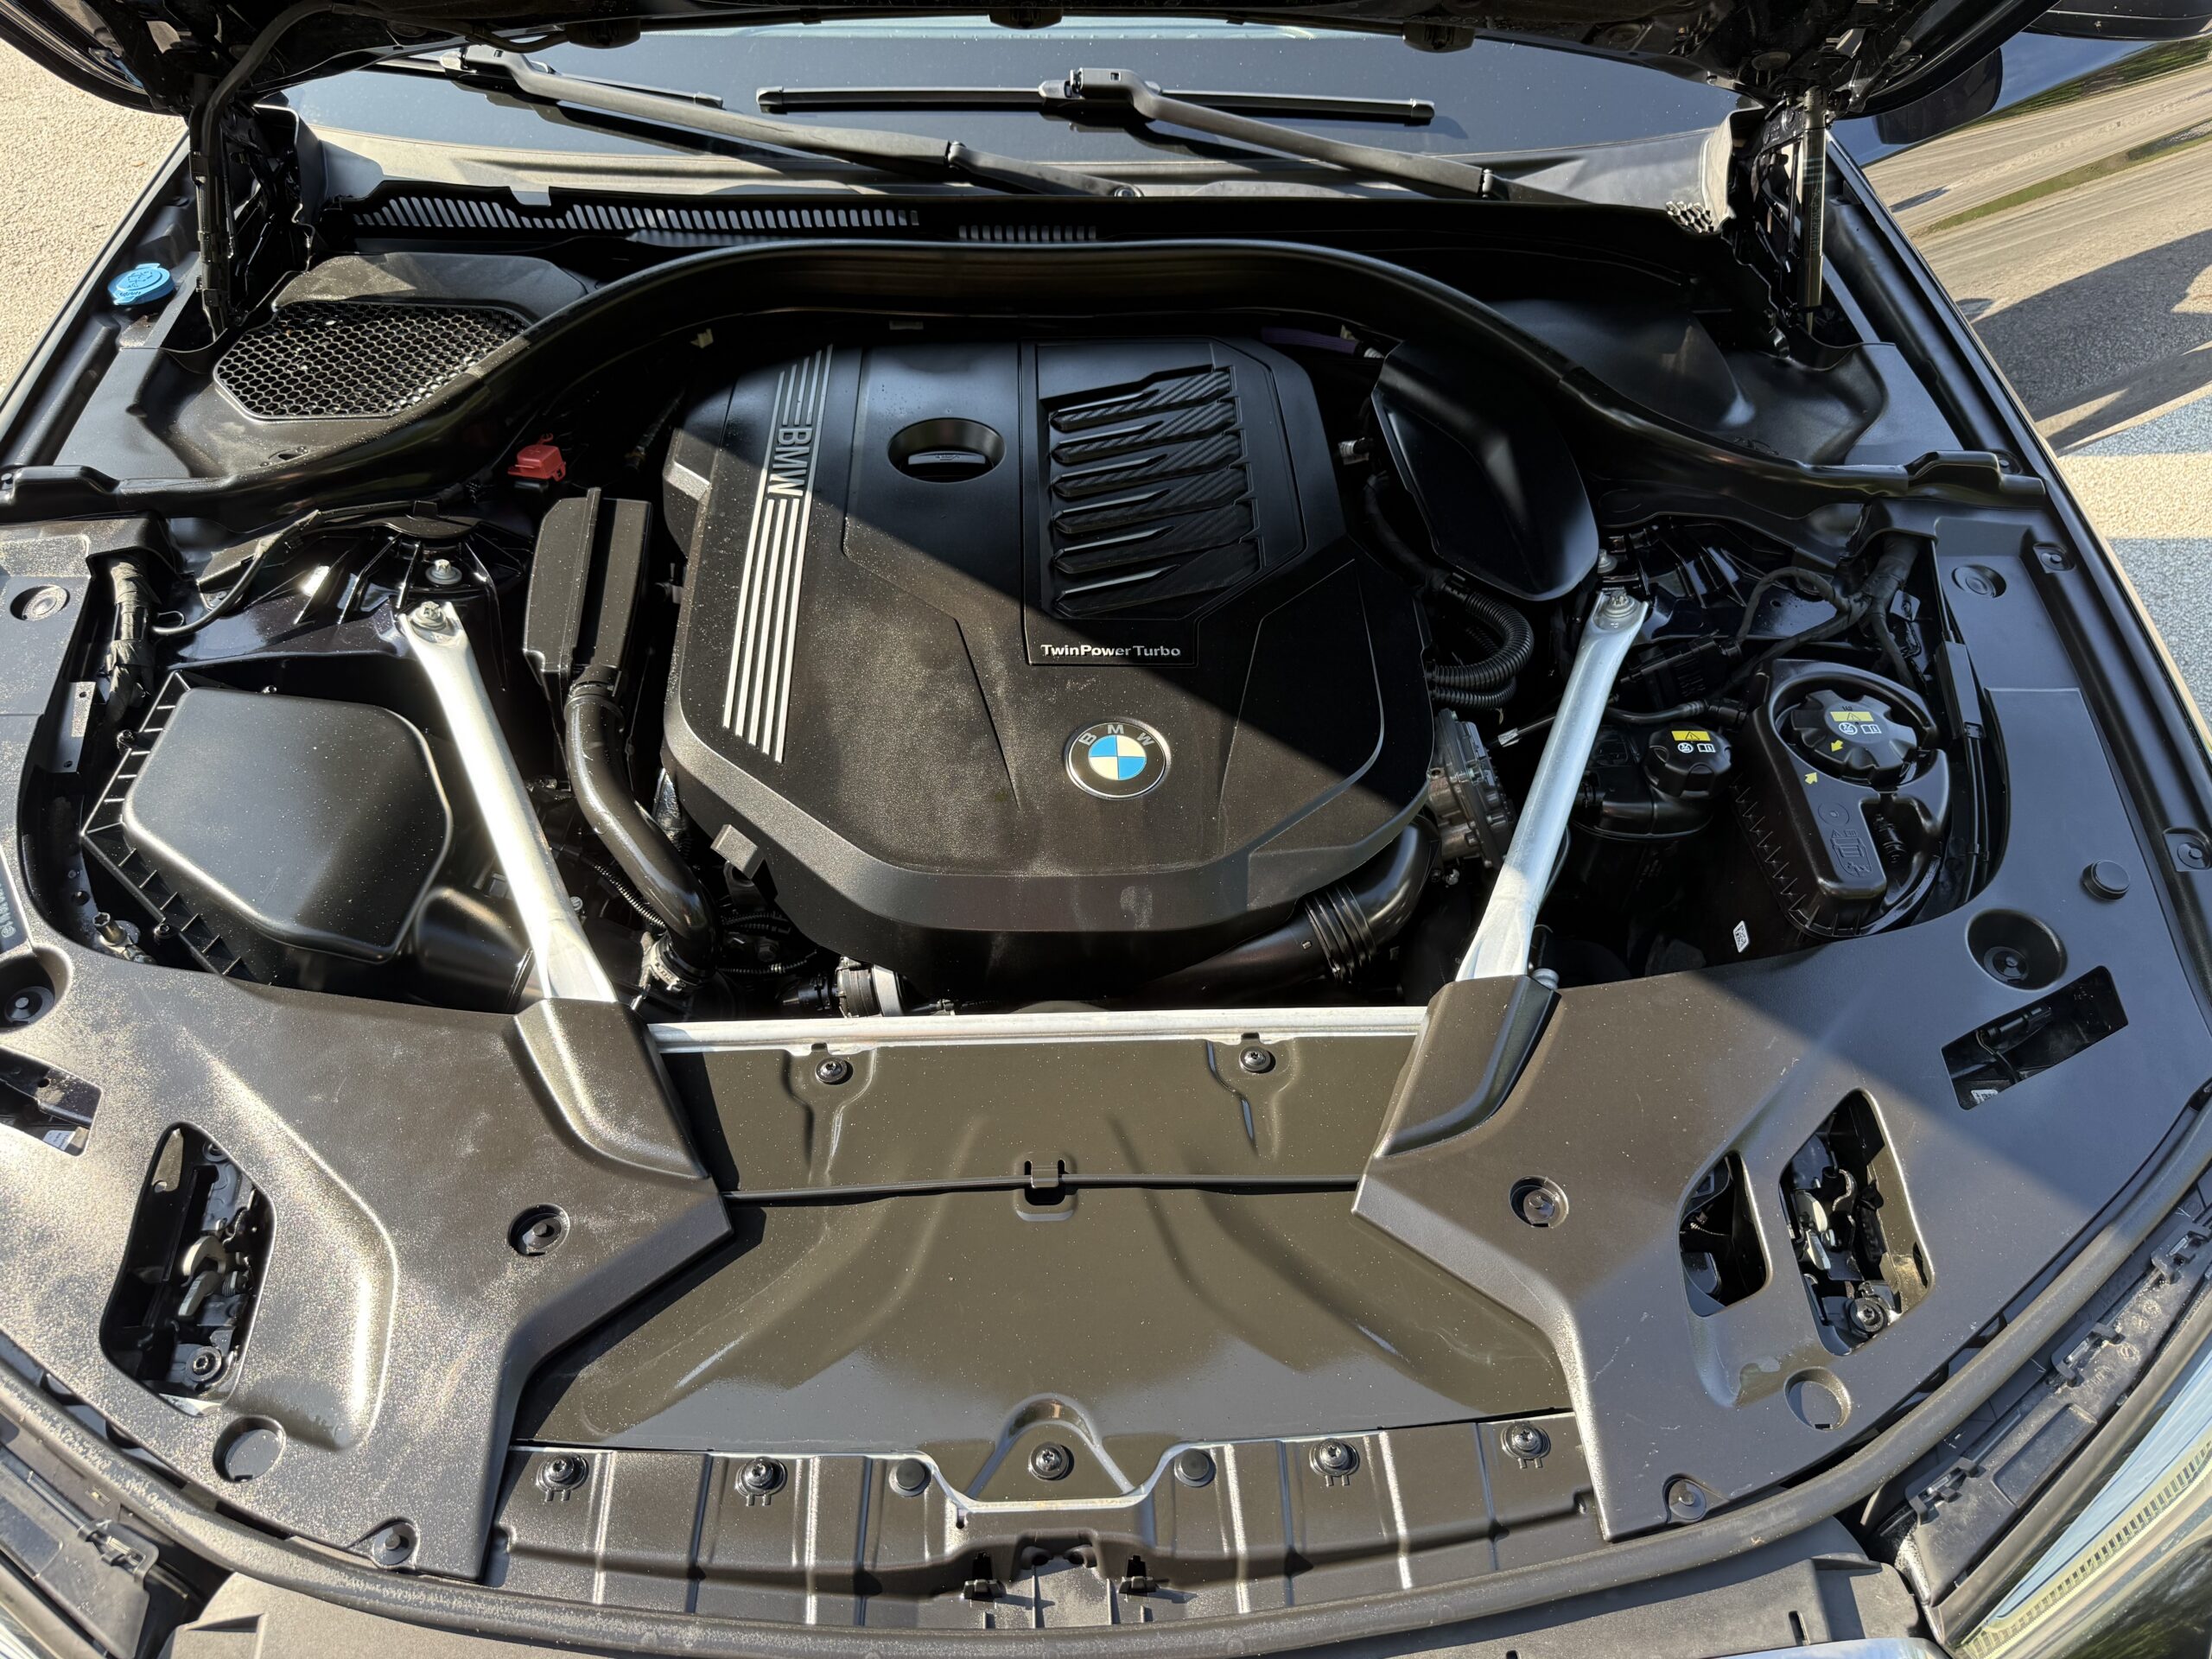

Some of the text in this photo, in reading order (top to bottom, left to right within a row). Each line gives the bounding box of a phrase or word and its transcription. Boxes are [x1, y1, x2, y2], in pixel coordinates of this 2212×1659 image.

[767, 428, 813, 497] BMW
[1040, 644, 1181, 657] TwinPower Turbo
[1078, 724, 1155, 747] BMW
